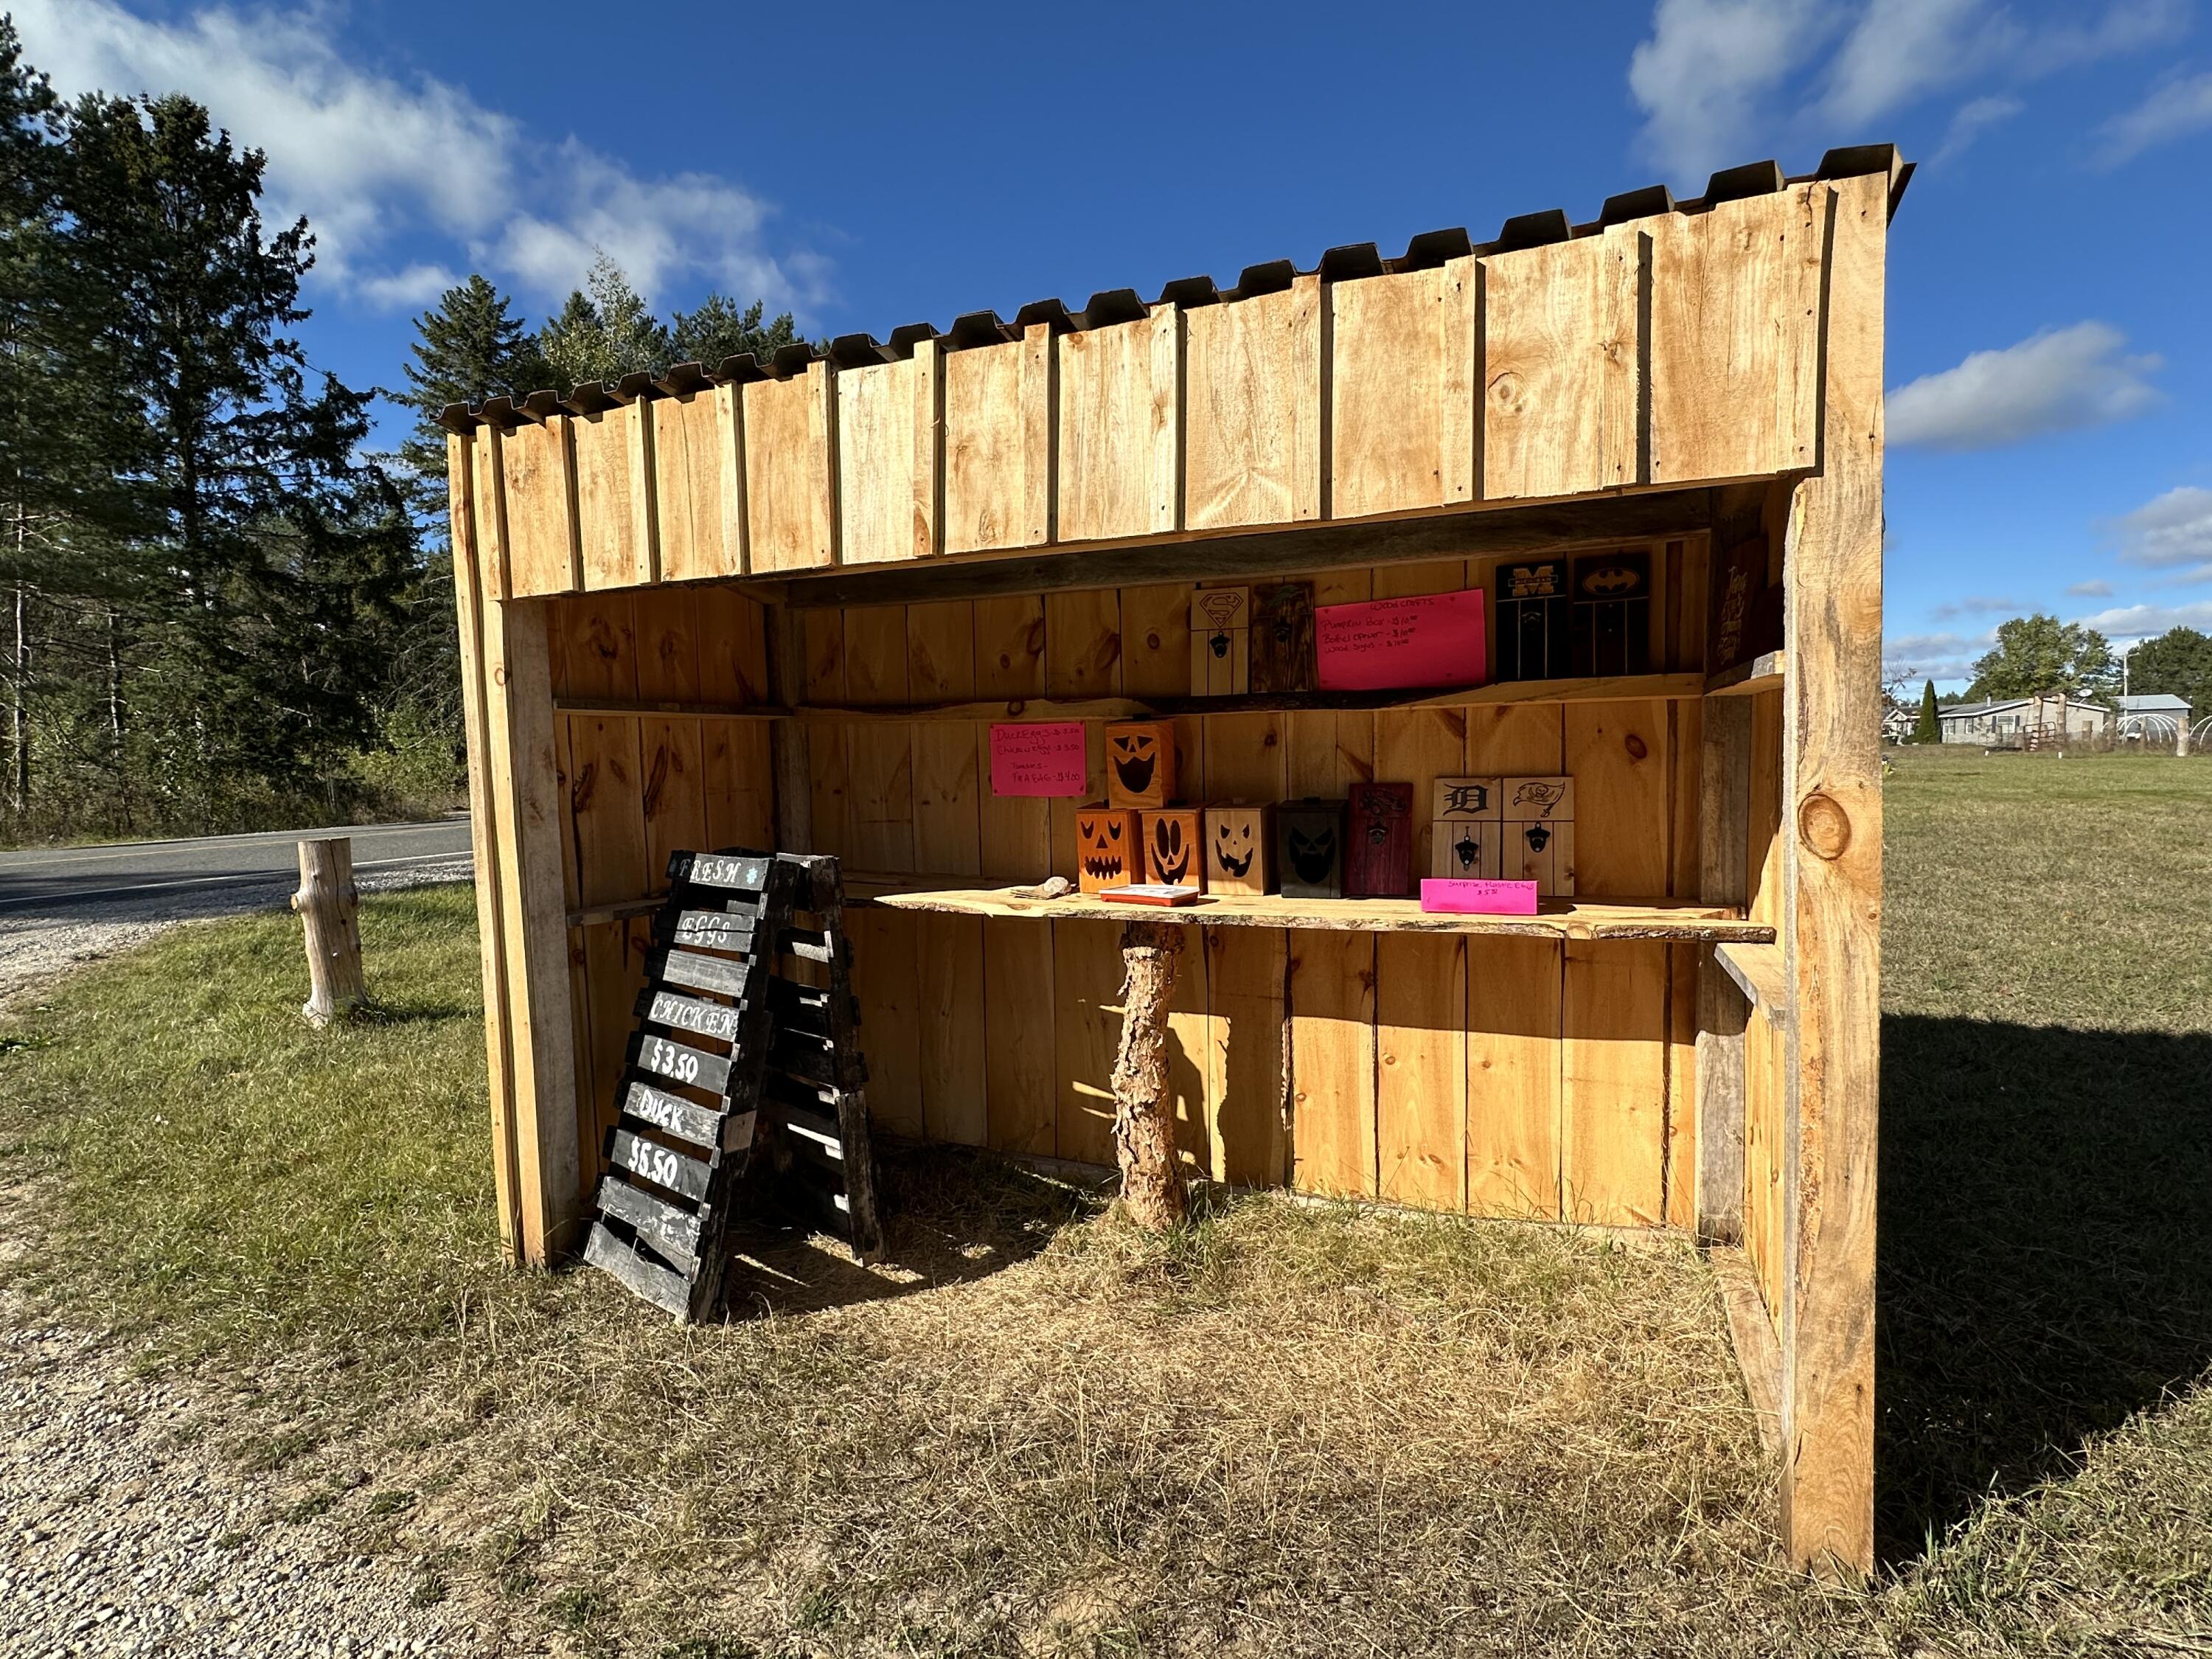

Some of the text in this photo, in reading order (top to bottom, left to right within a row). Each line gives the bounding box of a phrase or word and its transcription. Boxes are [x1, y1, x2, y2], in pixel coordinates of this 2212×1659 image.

[679, 858, 742, 883] FRESH
[681, 915, 731, 946] EGGS
[650, 998, 739, 1036] CHICKEN
[650, 1037, 699, 1083] $3.50
[639, 1089, 683, 1133] DUCK
